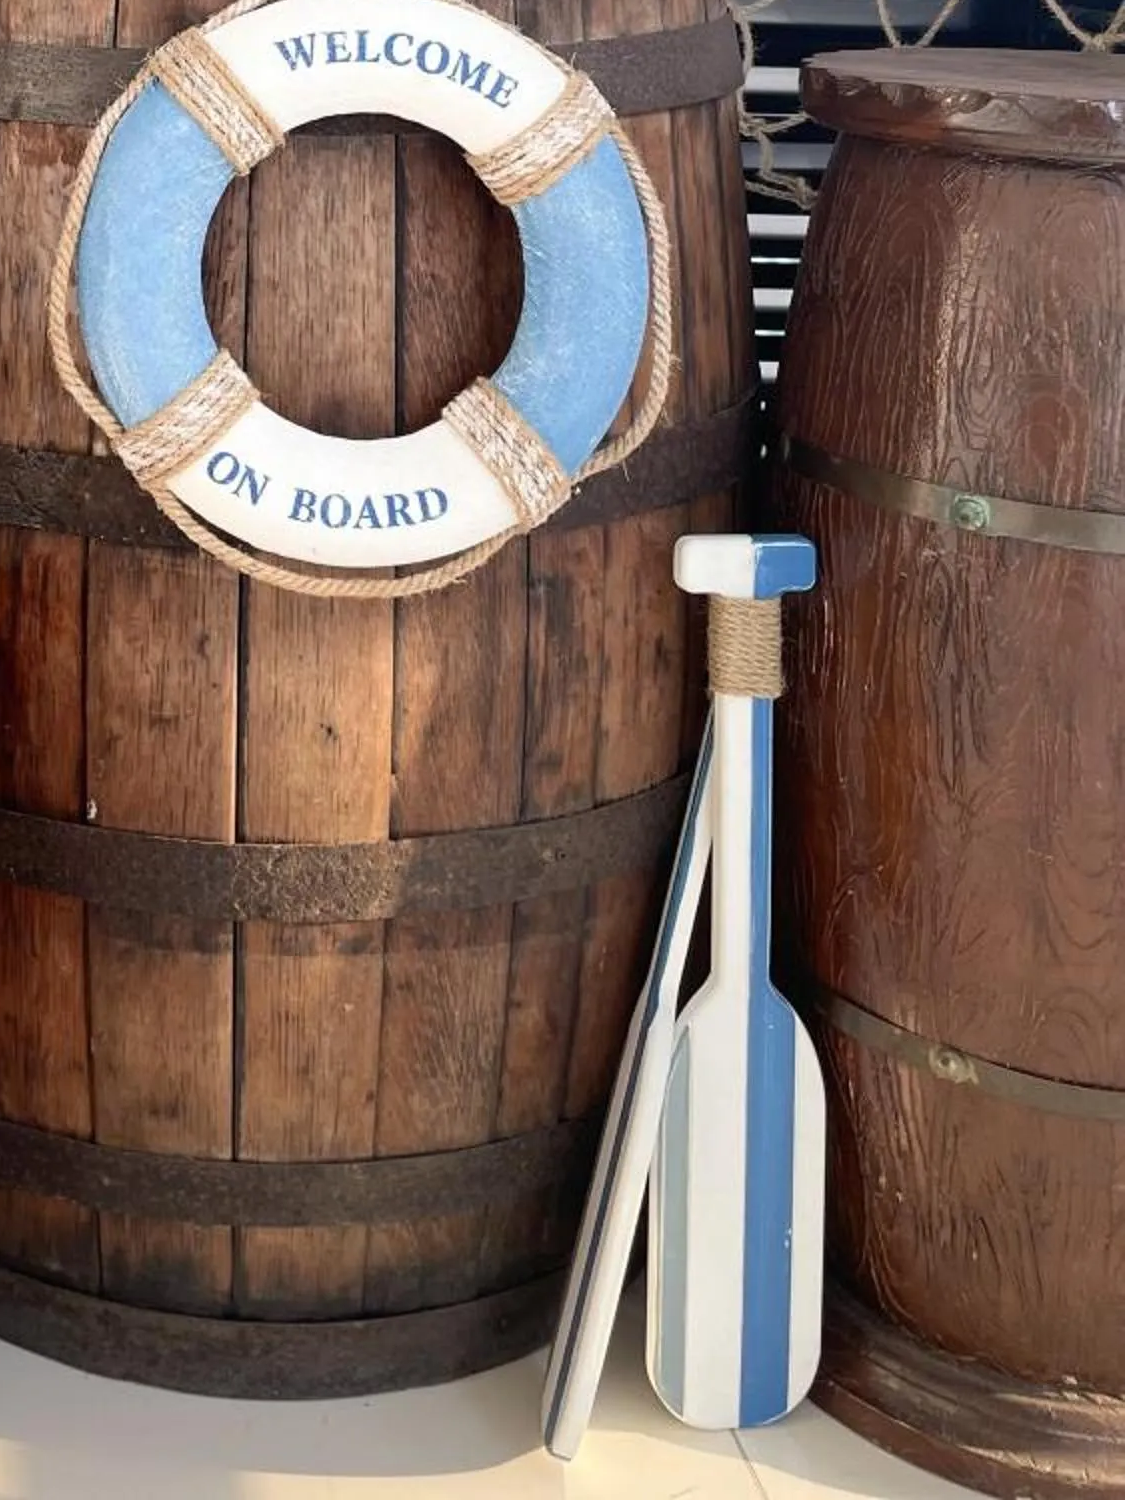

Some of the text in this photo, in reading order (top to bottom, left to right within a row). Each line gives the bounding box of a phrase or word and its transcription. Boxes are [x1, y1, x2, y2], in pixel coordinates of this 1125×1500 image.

[273, 29, 520, 109] WELCOME
[205, 451, 448, 530] ON BOARD
